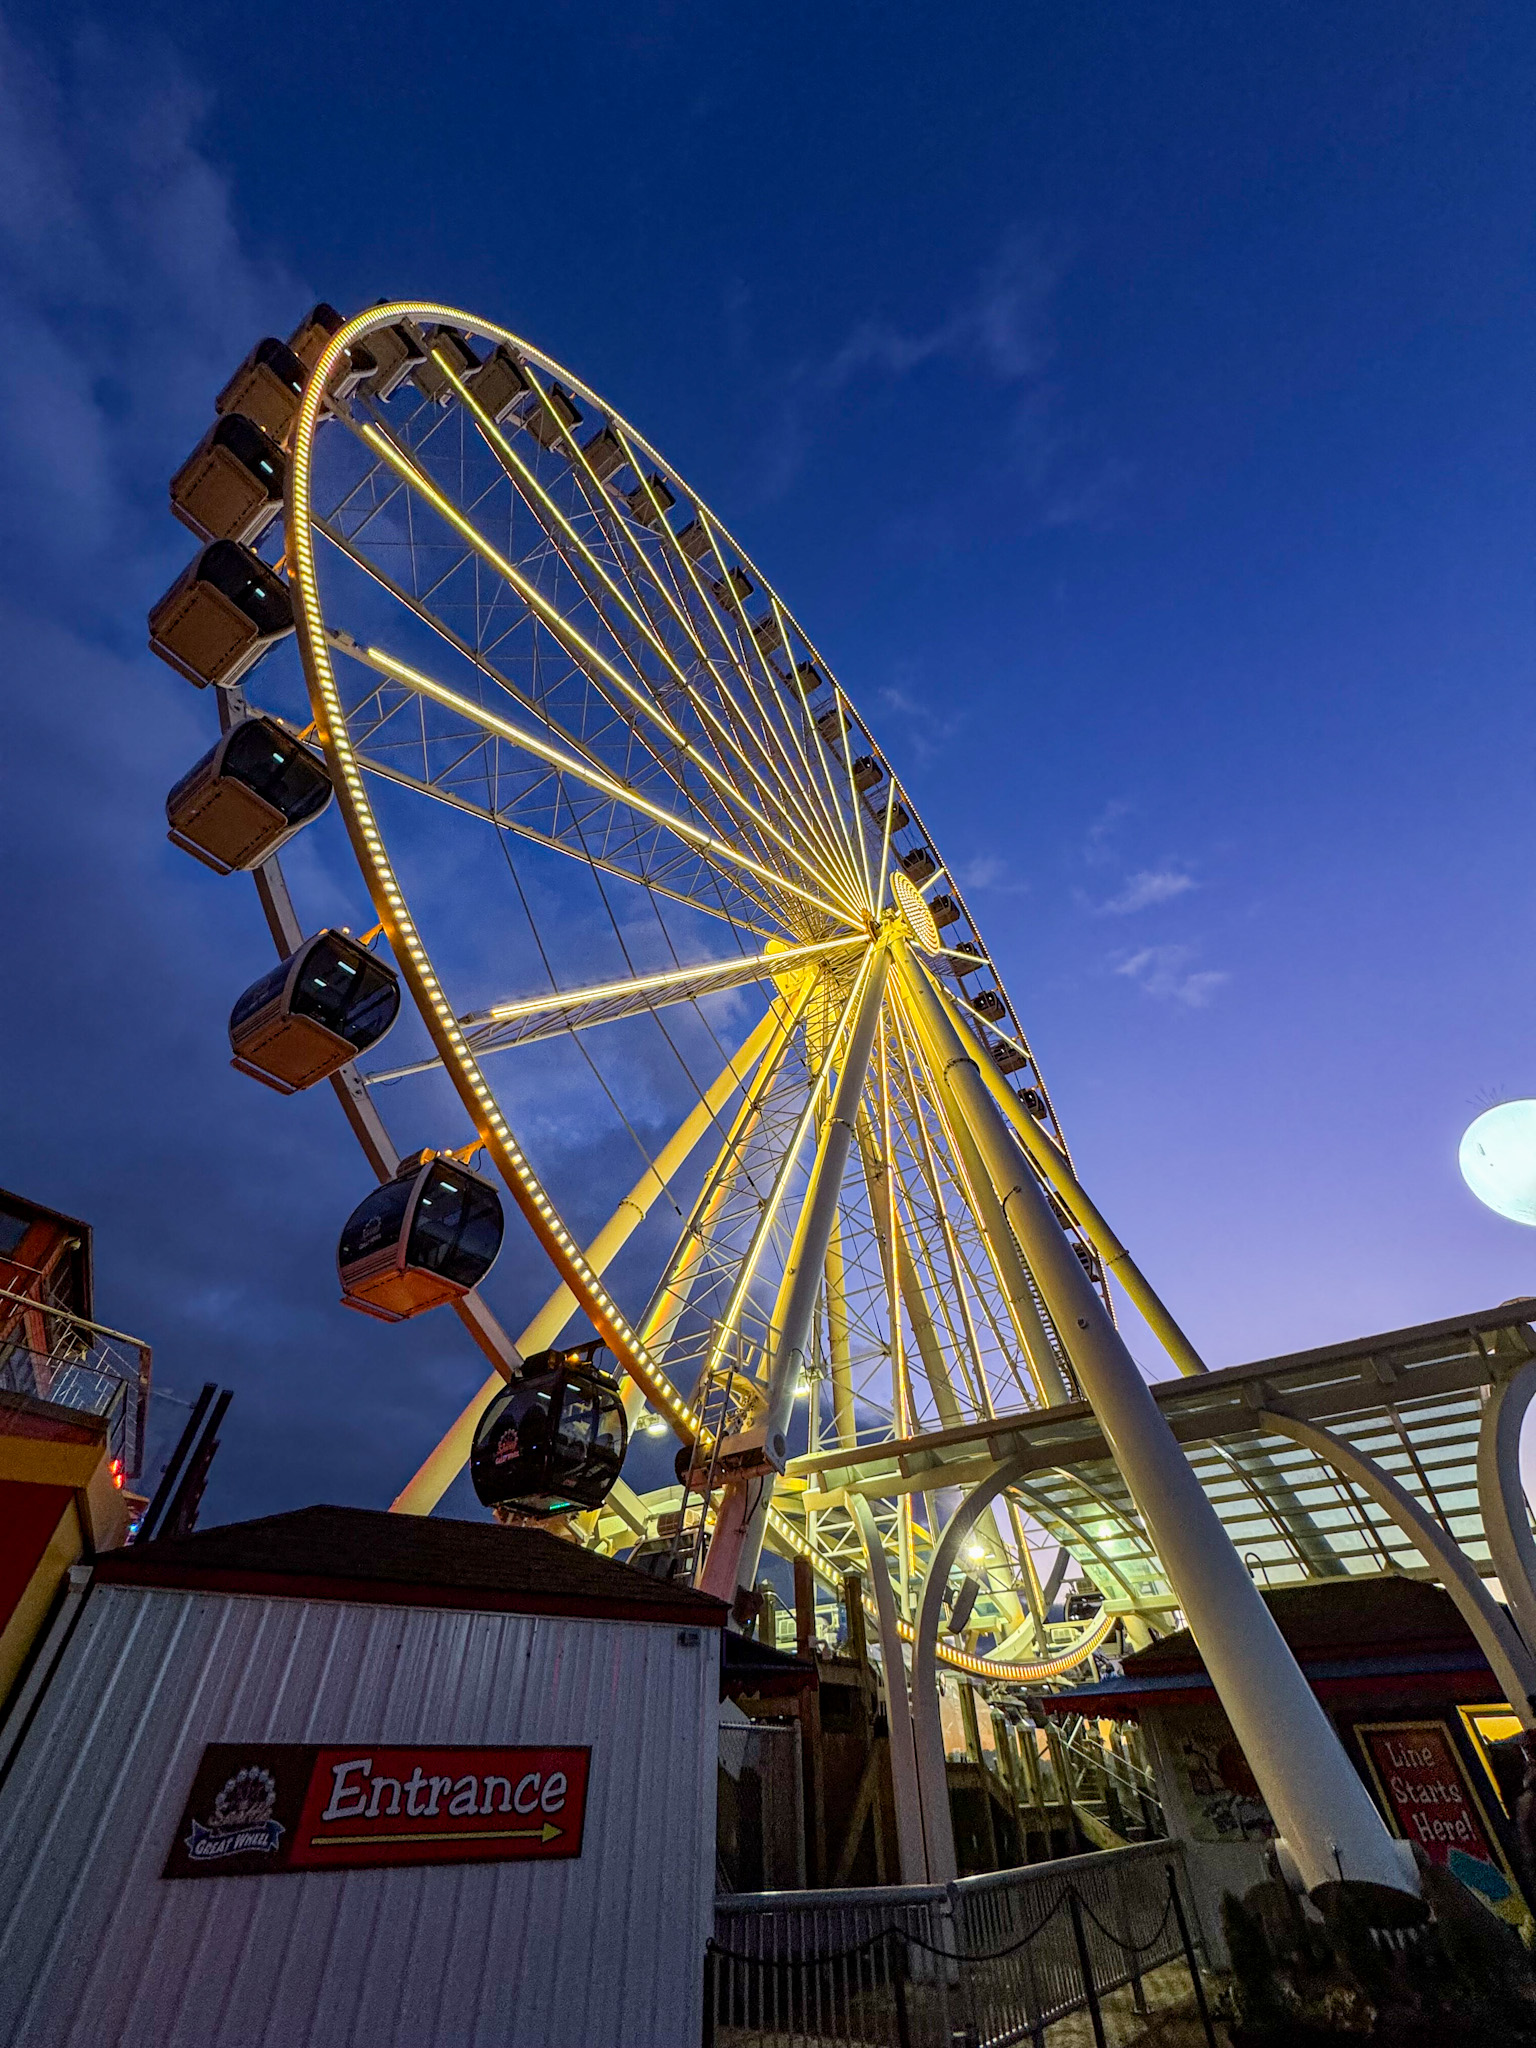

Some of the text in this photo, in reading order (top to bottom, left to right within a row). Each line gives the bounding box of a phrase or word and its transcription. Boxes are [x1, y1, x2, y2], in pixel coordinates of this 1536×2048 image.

[1385, 1742, 1434, 1768] Line
[322, 1758, 567, 1821] Entrance
[1391, 1776, 1463, 1804] Starts
[1412, 1810, 1477, 1842] Here!
